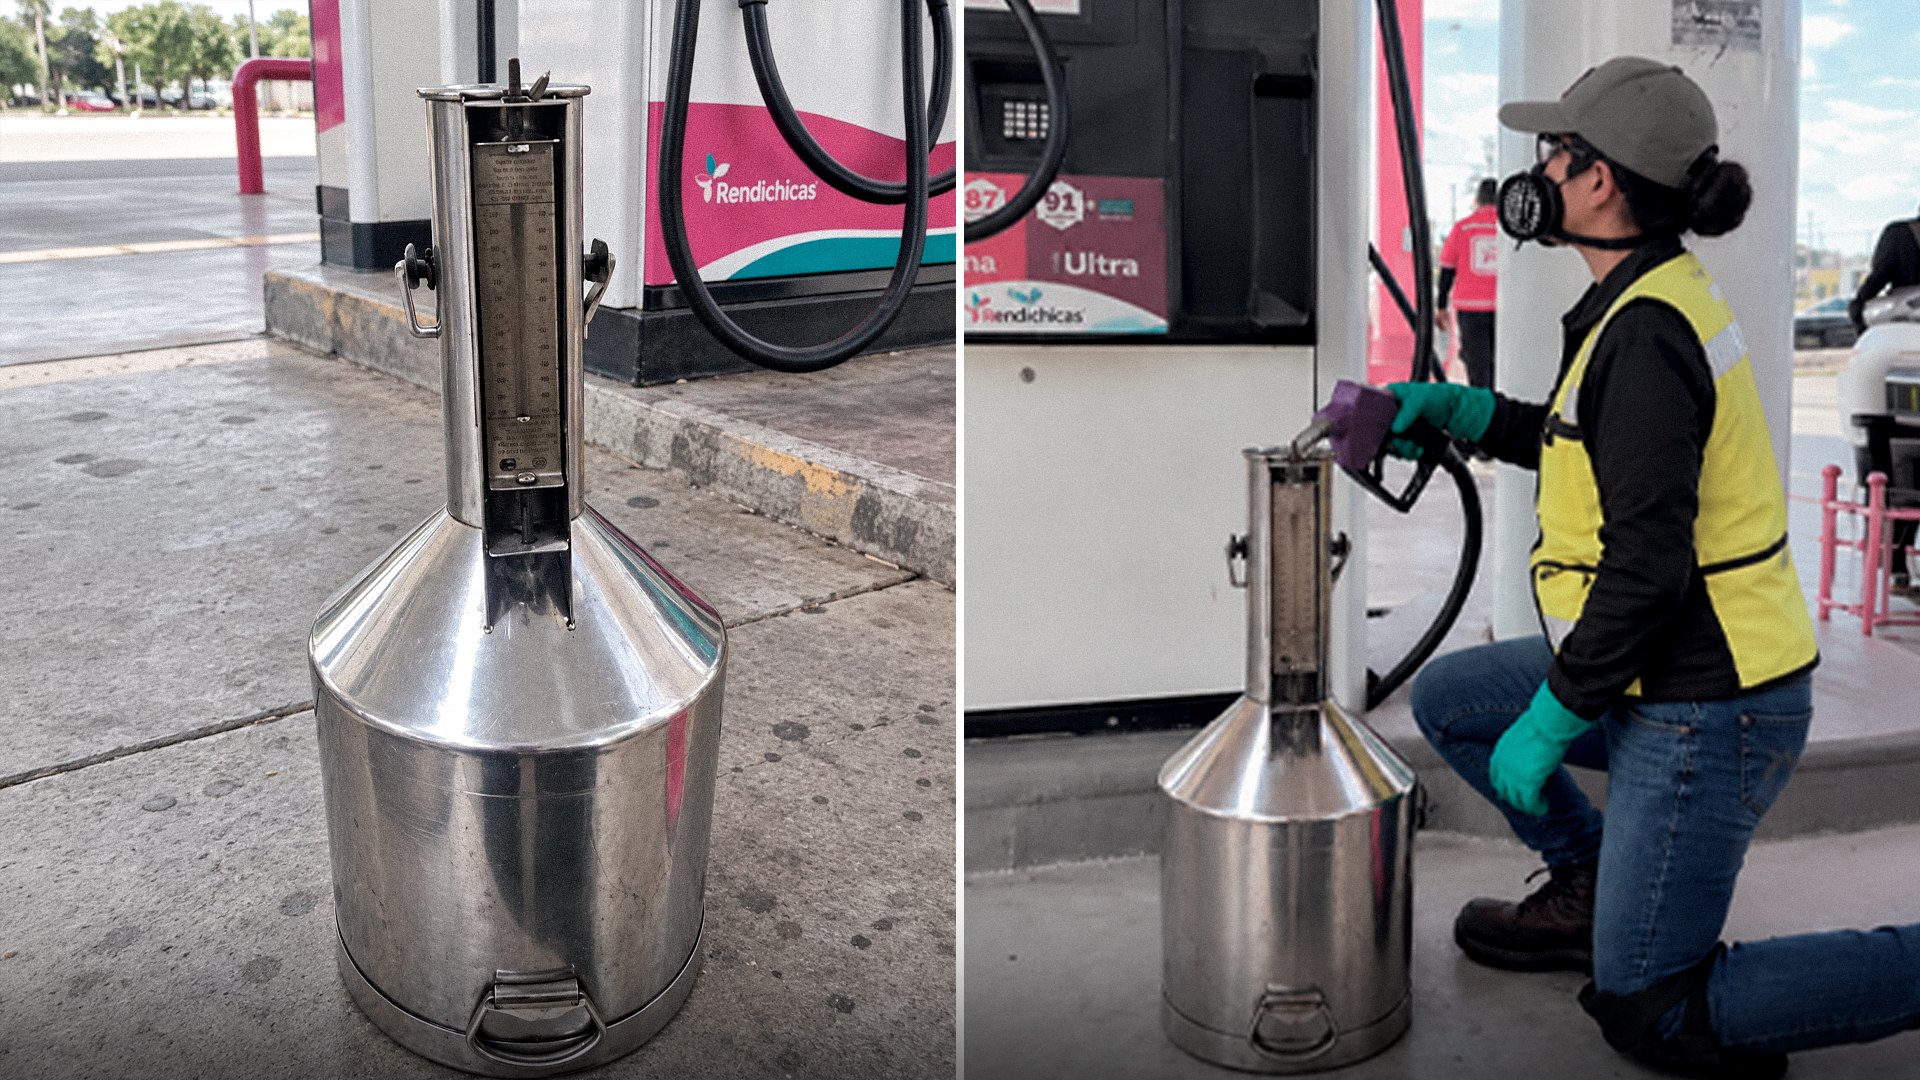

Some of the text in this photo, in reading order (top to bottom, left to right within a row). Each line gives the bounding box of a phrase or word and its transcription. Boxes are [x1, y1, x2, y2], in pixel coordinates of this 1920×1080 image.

[716, 179, 817, 204] Rendichicas
[965, 188, 998, 210] 87
[1045, 191, 1076, 211] 91
[1064, 251, 1139, 276] Ultra
[982, 307, 1081, 324] Rendichicas
